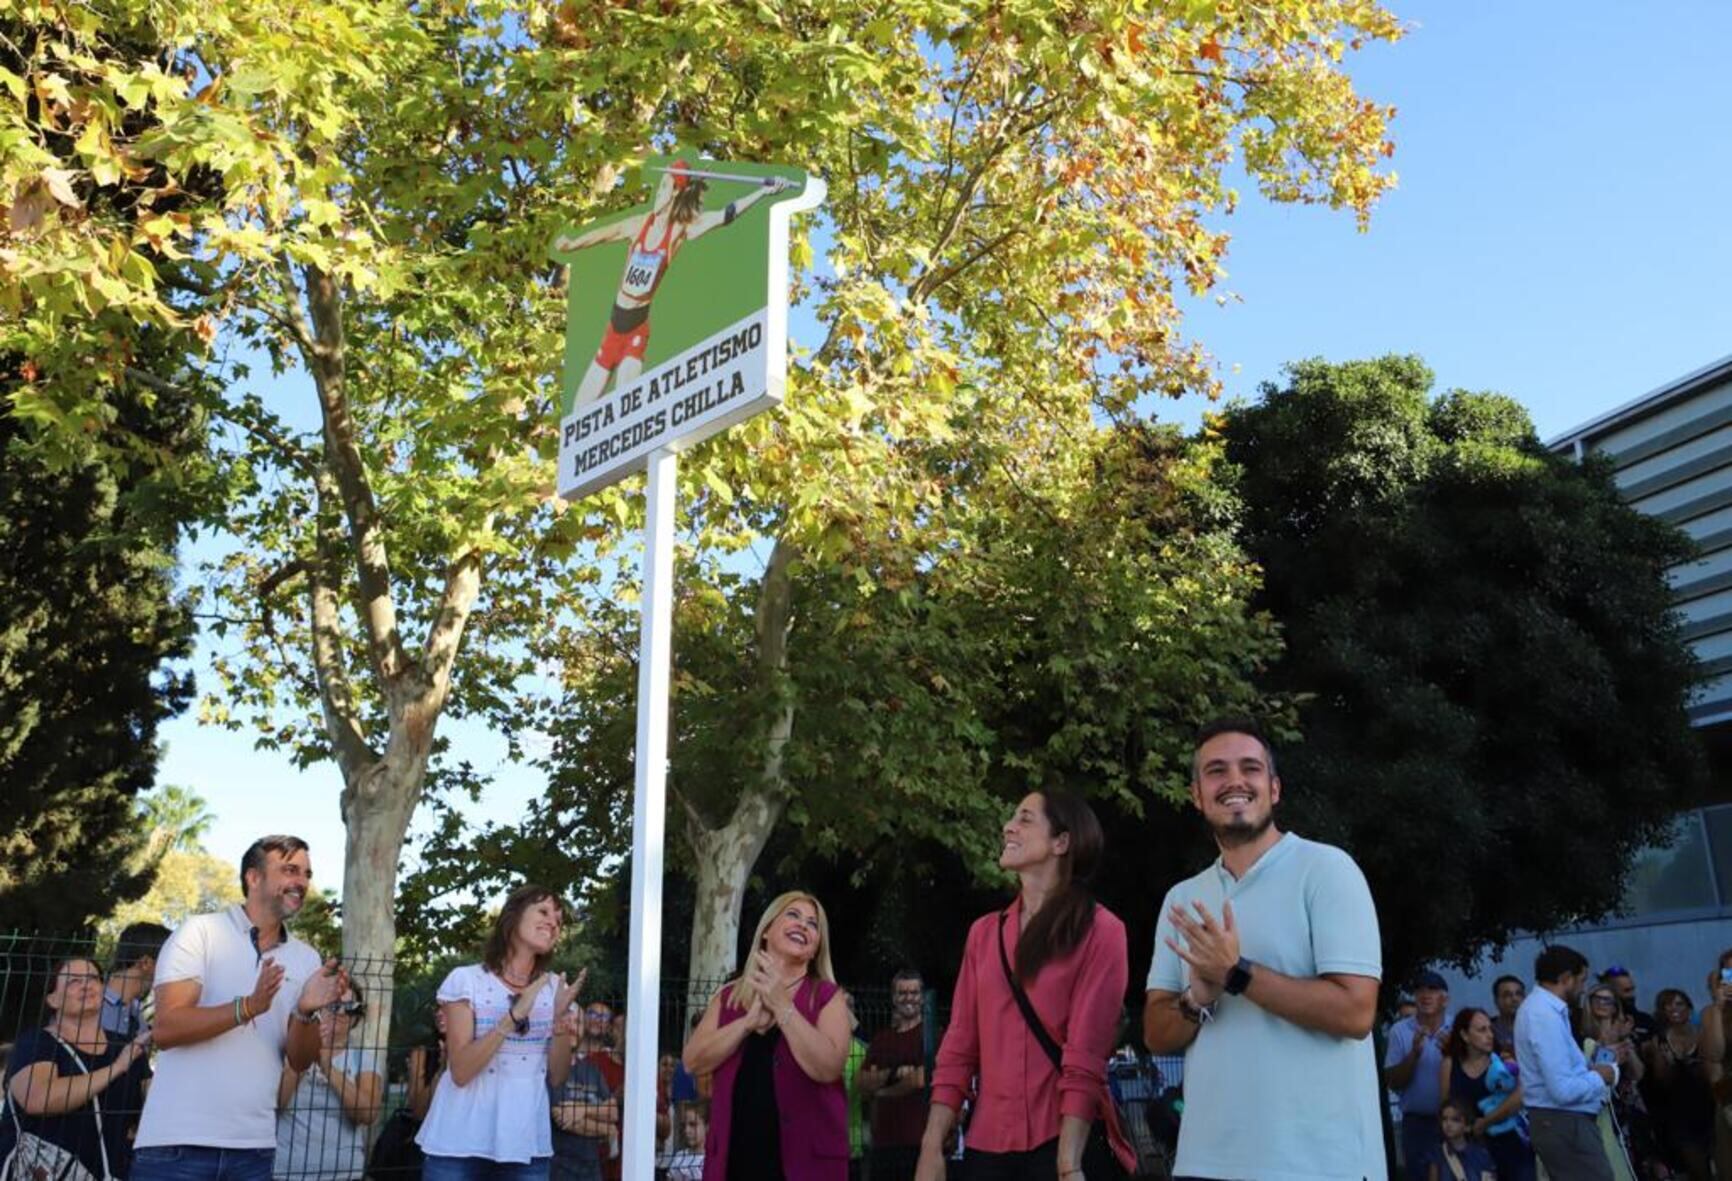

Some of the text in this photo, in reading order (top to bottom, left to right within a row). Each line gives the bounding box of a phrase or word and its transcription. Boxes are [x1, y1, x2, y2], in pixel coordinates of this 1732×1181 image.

[564, 322, 762, 448] PISTA DE ATLETISMO
[573, 371, 745, 477] MERCEDES CHILLA
